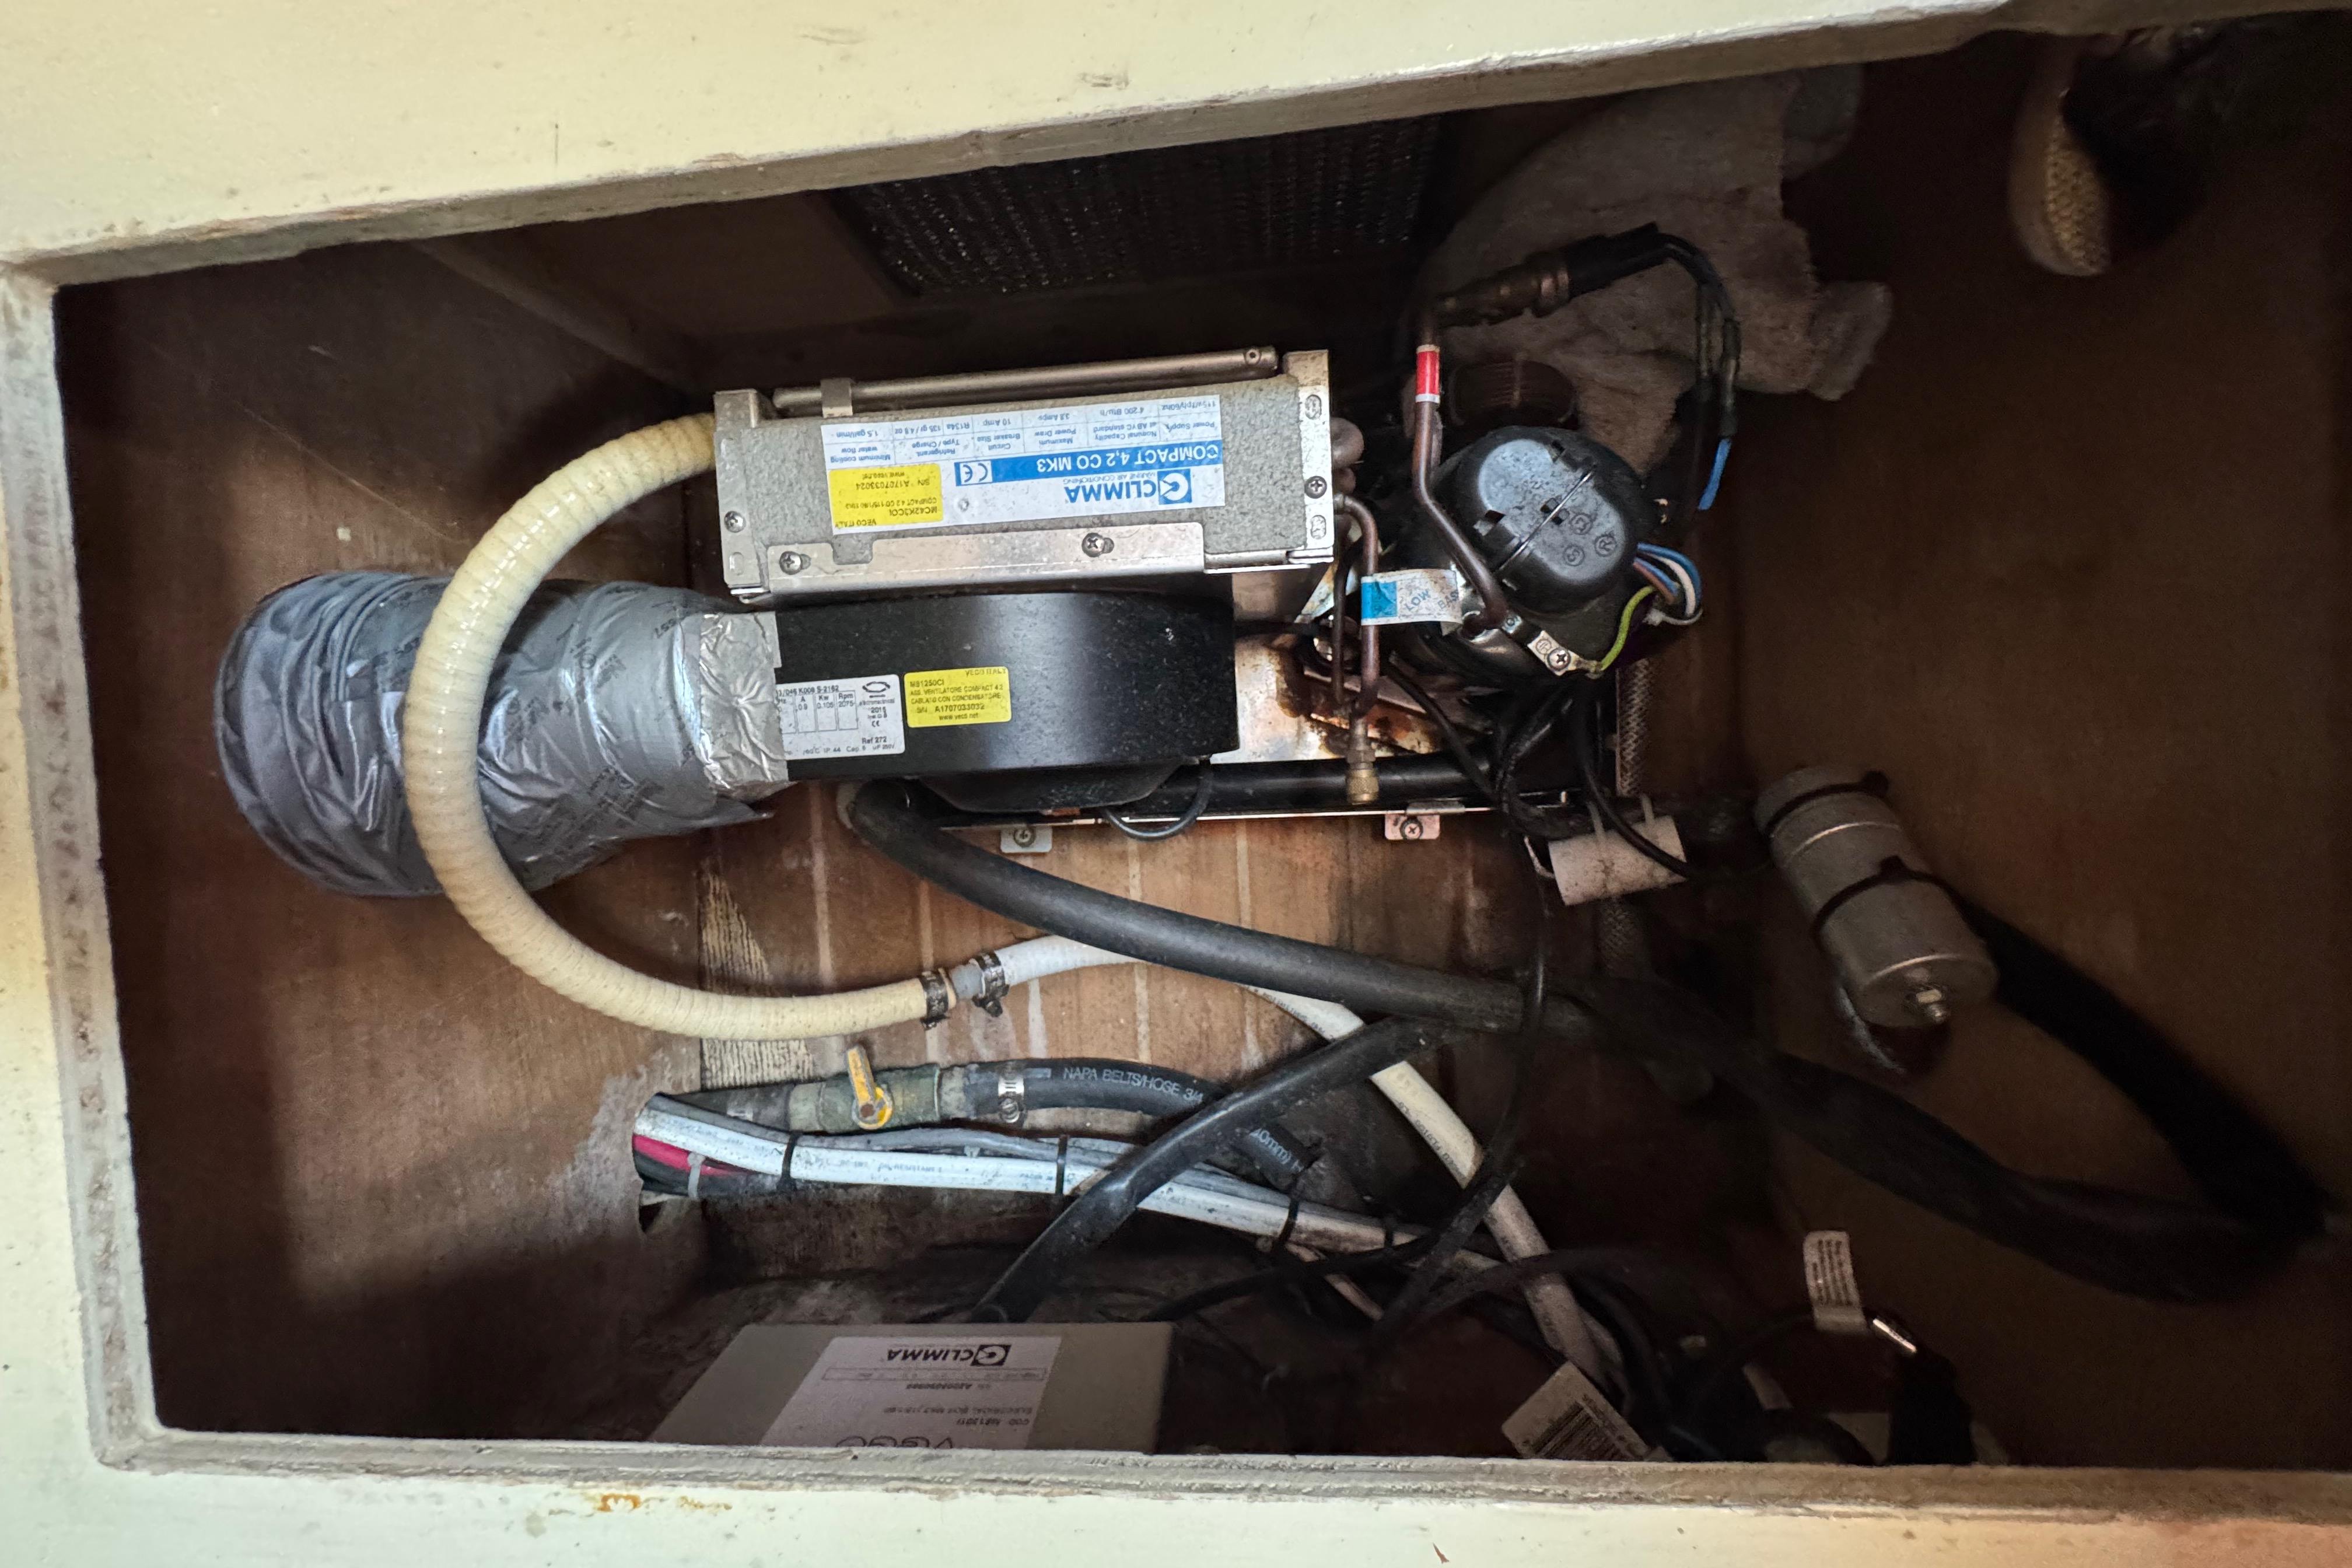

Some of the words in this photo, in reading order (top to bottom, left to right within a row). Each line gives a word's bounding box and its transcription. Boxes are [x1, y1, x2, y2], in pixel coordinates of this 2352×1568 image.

[1038, 438, 1073, 446] Maximum
[1094, 432, 1125, 441] Capacity
[911, 440, 937, 449] Charge
[916, 447, 955, 457] Refrigerant
[1105, 450, 1130, 466] 4,2
[1134, 444, 1219, 464] COMPACT
[830, 455, 856, 464] cooling
[1035, 456, 1072, 472] MK3
[1076, 453, 1101, 468] CO
[1063, 480, 1157, 503] CLIMMA
[856, 518, 876, 527] VECO
[1404, 589, 1431, 611] LOW
[1063, 1066, 1098, 1082] NAPA
[1102, 1068, 1181, 1097] BELTS/HOSE
[886, 1349, 973, 1360] CLIMMA
